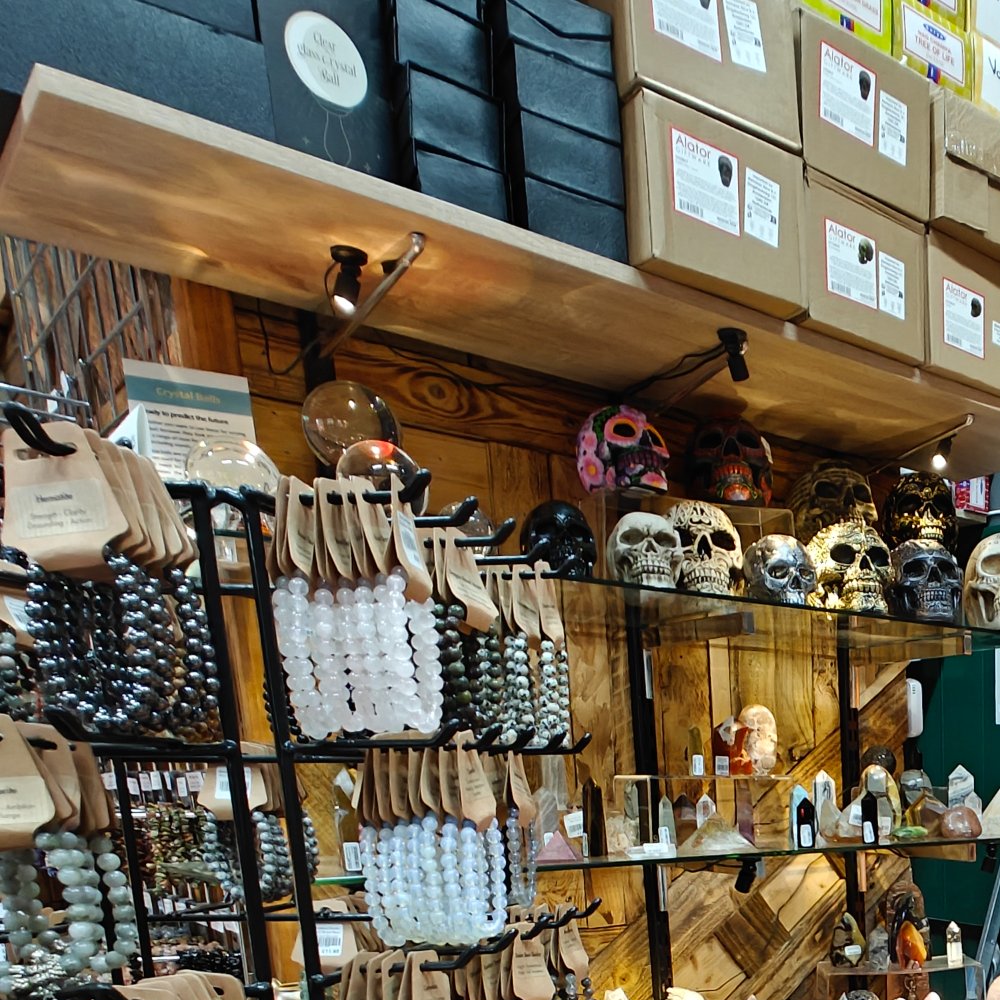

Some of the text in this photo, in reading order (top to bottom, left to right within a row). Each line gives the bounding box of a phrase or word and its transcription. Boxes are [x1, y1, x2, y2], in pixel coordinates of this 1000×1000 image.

[915, 35, 955, 66] TREE OF LIFE
[321, 58, 357, 78] Crystal
[824, 48, 854, 74] Alator
[321, 69, 340, 87] Ball
[676, 135, 711, 159] Alator
[828, 223, 856, 242] Alator
[945, 283, 968, 299] Alator
[155, 387, 194, 401] Crystal
[170, 411, 195, 421] predict
